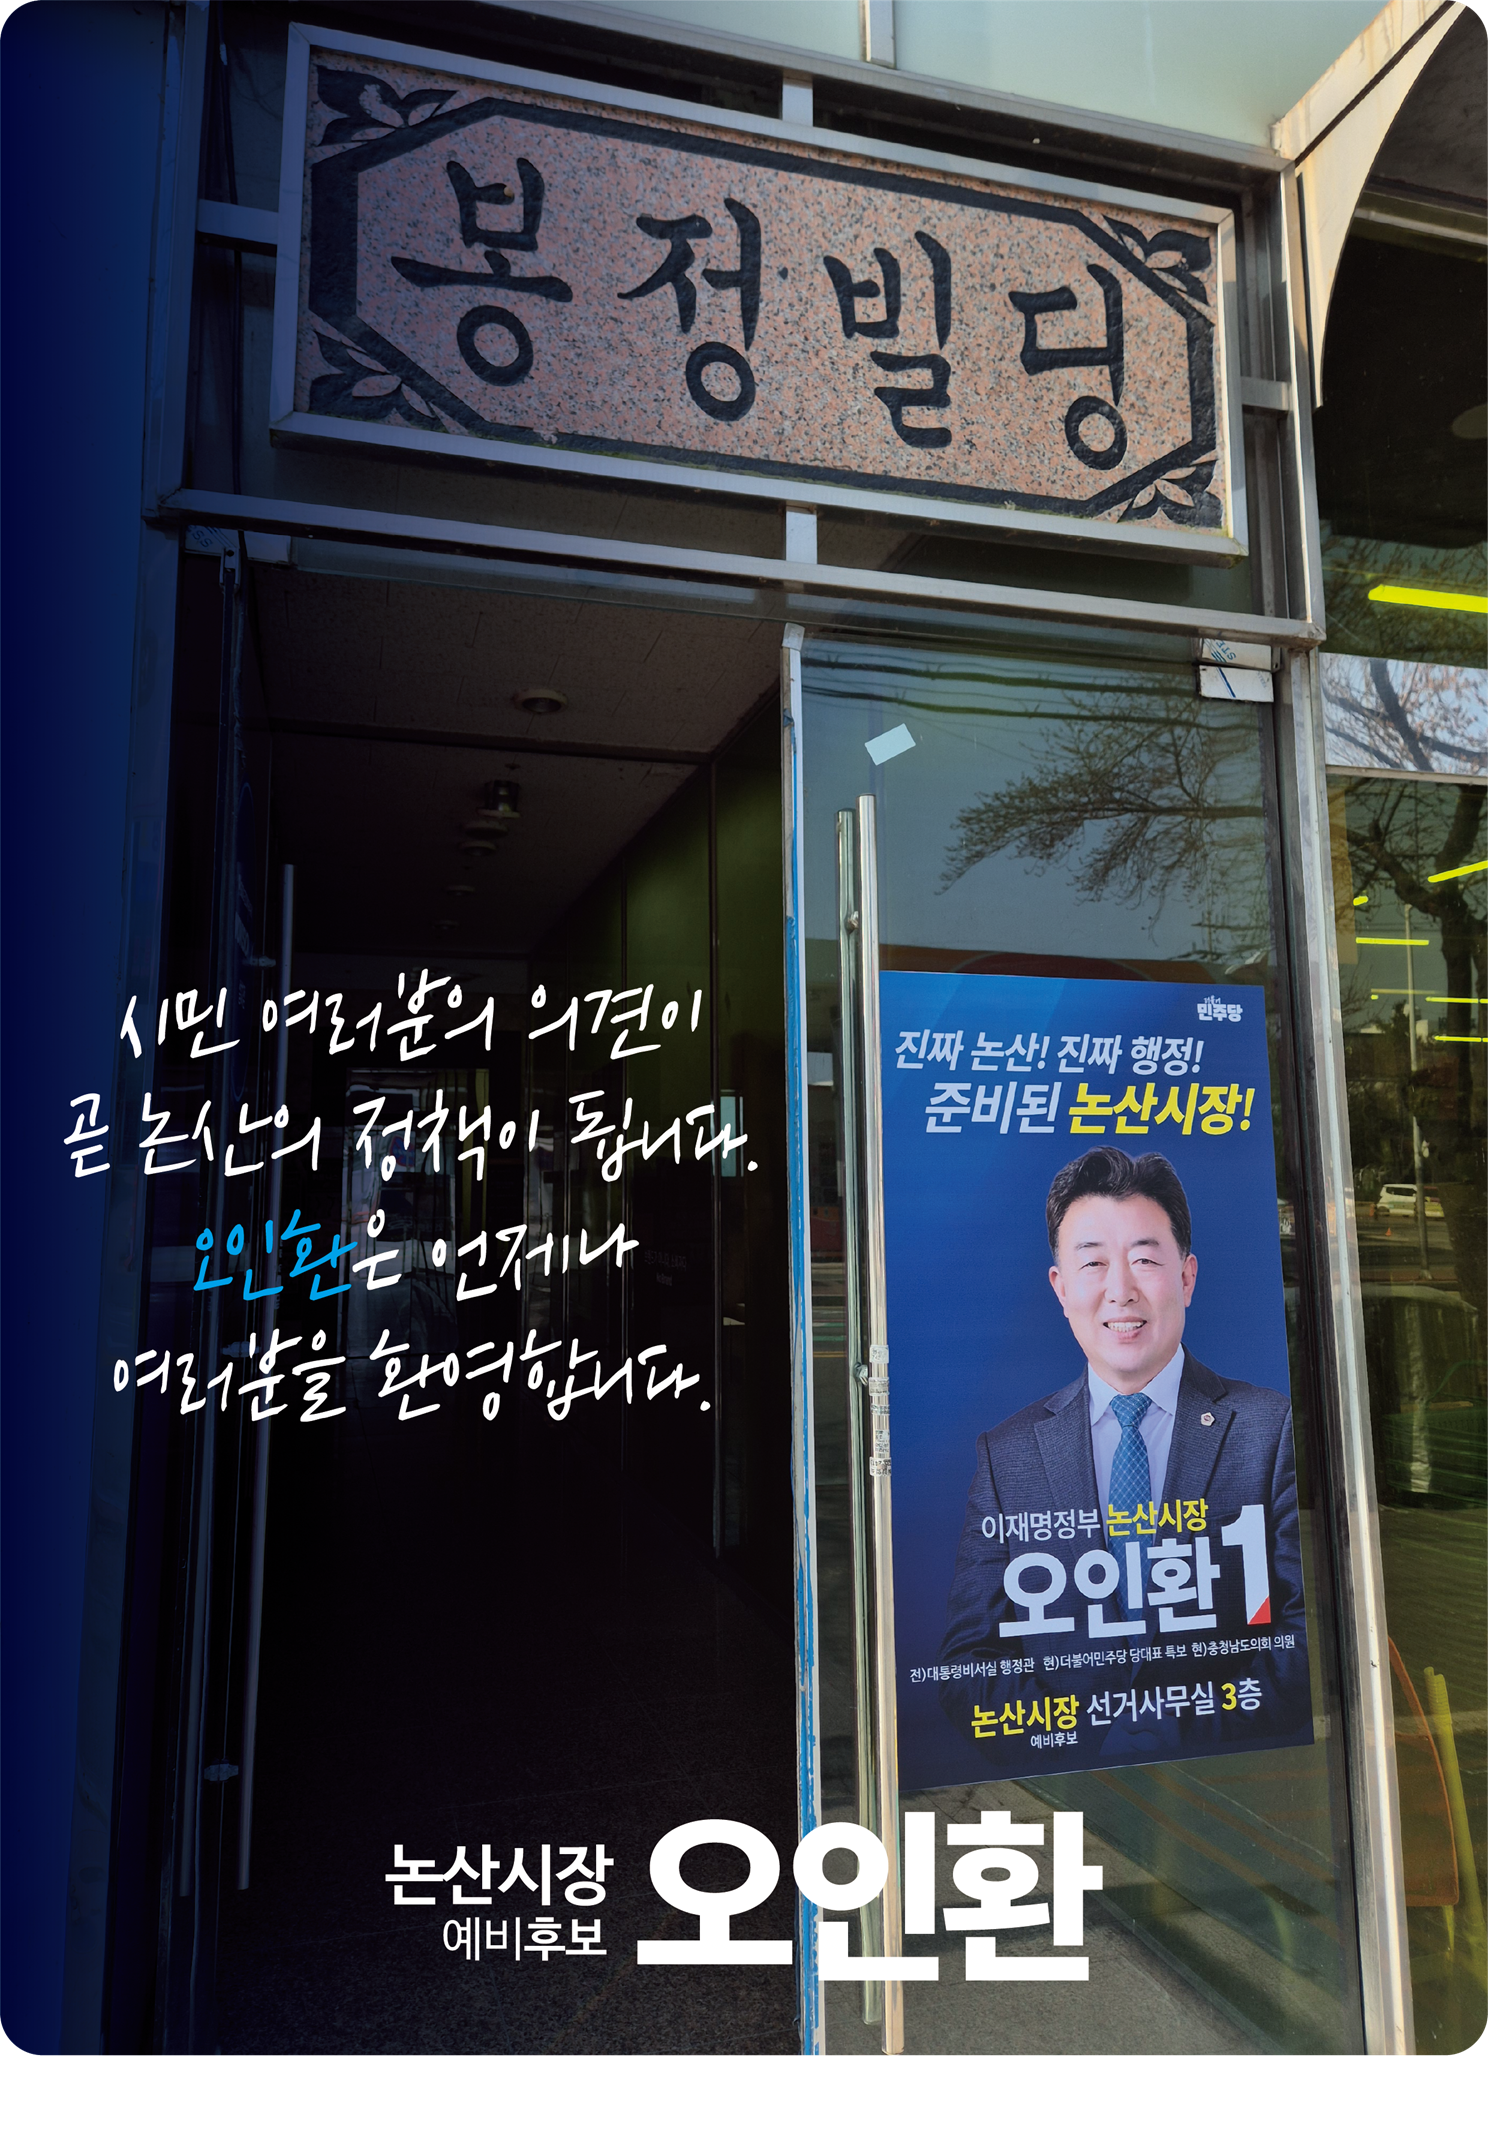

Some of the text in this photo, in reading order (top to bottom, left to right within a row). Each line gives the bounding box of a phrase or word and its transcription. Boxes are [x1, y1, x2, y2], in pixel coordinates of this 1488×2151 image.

[391, 157, 1128, 470] 봉정빌딩
[1214, 640, 1236, 660] STE
[1197, 1003, 1243, 1022] 민주당
[895, 1029, 1204, 1076] 진짜 논산! 진짜 행정!
[925, 1081, 1255, 1135] 준비된 논산시장!
[981, 1498, 1209, 1544] 이재명정부 논산시장
[999, 1504, 1271, 1639] 오인환 1
[909, 1634, 1296, 1683] 전)대통령비서실 행정관 현)더불어민주당 당대표 특보 현)충청남도의회 의원
[971, 1677, 1262, 1739] 논산시장 선거사무실 3층
[1030, 1730, 1078, 1749] 예비후보
